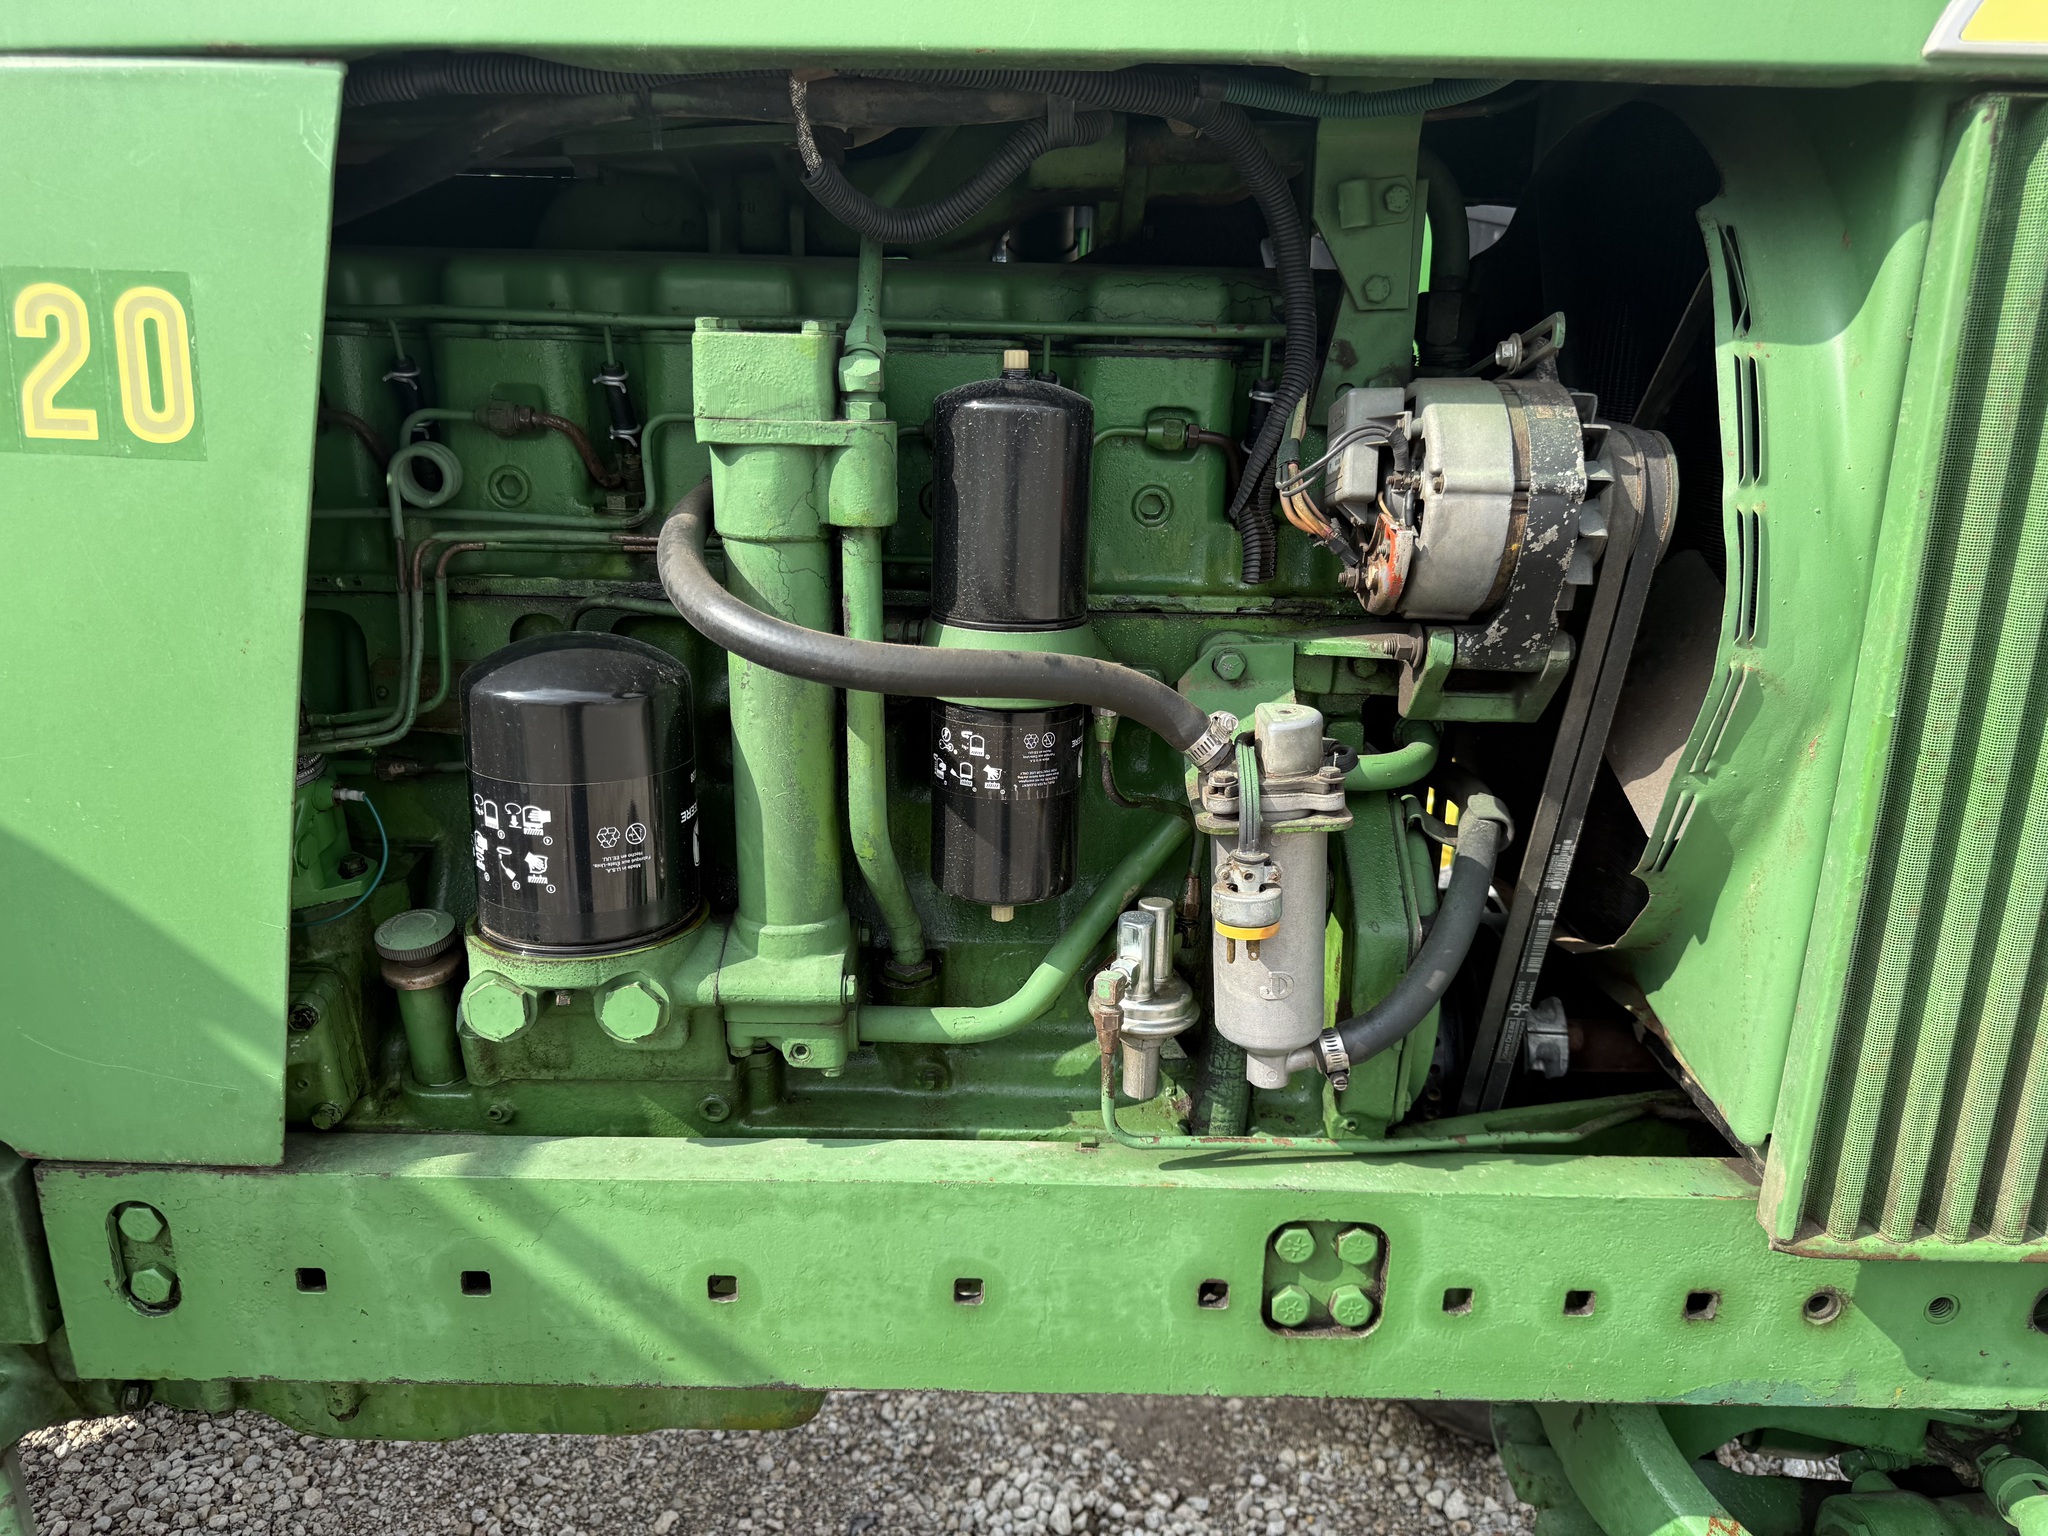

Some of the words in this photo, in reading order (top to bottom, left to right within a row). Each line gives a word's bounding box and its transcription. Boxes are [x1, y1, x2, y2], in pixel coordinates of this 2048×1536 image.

[15, 283, 195, 443] 20
[1259, 971, 1294, 1001] JD
[1505, 1020, 1516, 1042] DEERE
